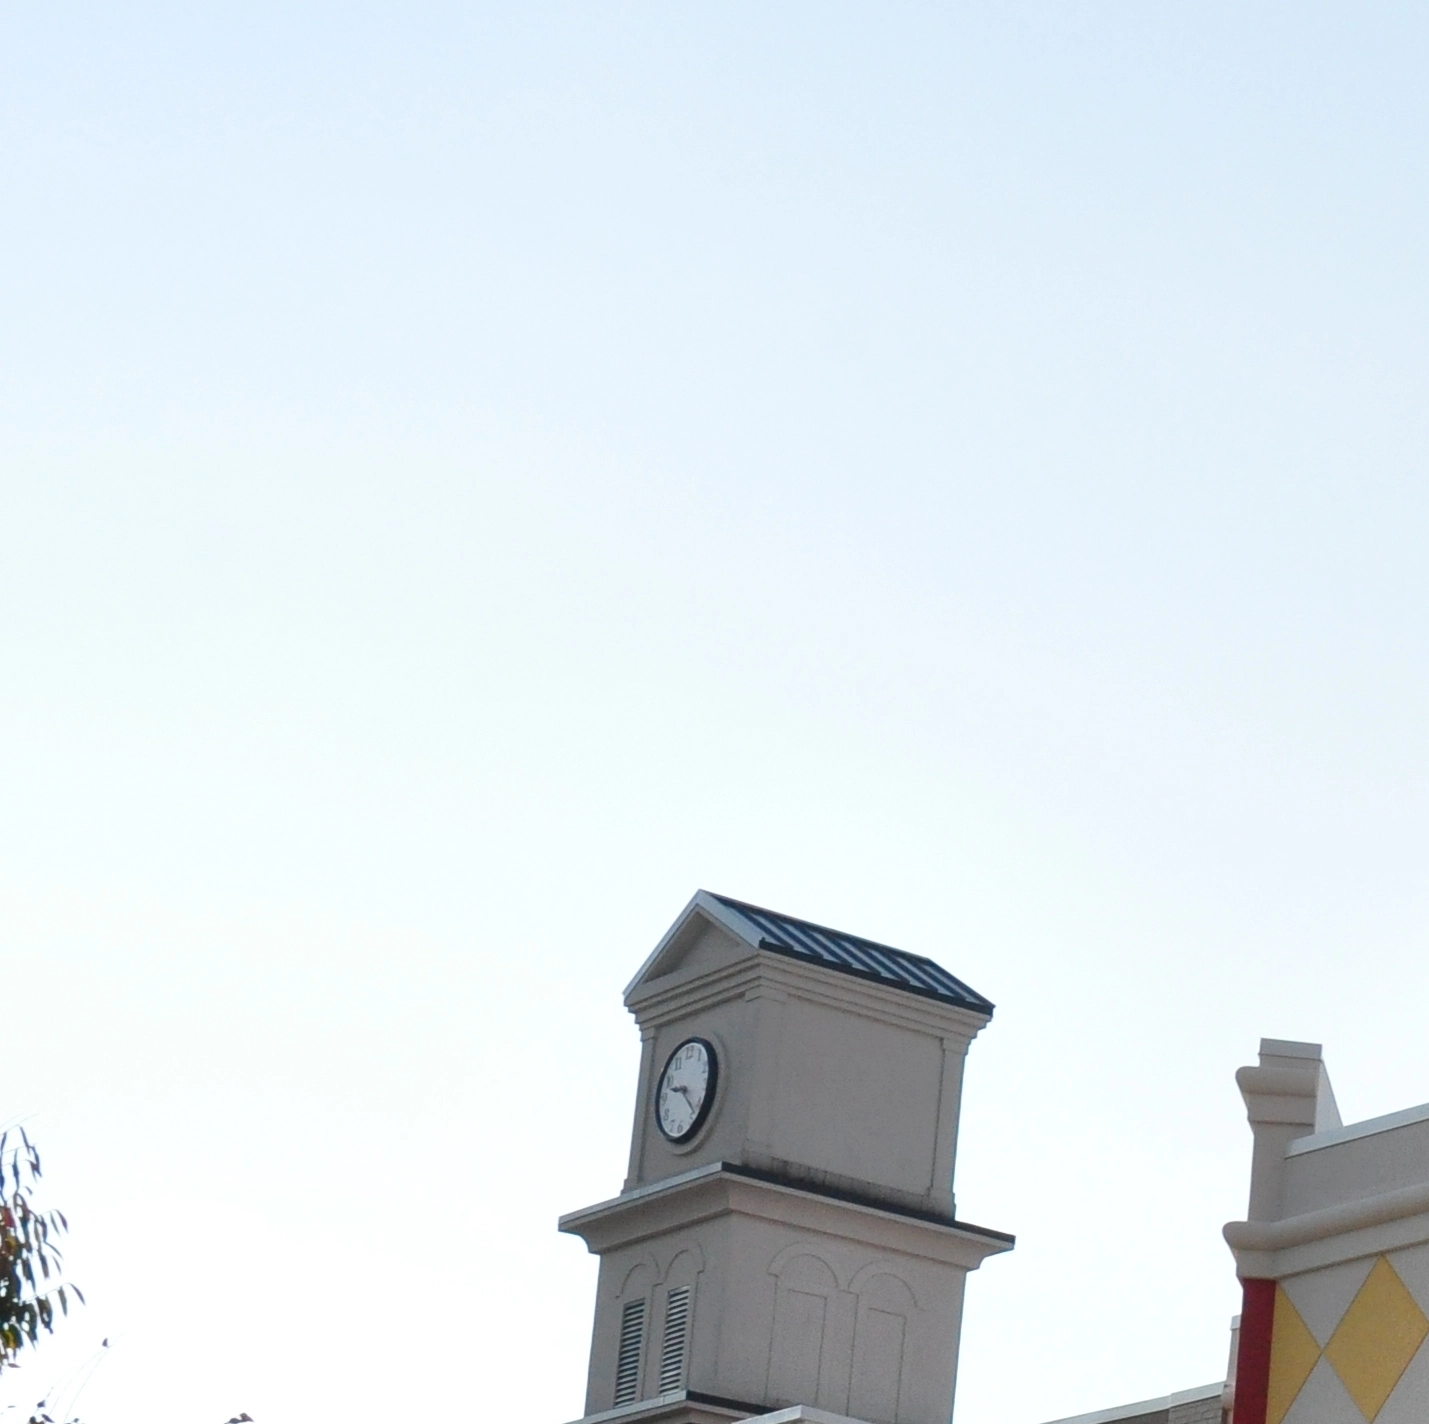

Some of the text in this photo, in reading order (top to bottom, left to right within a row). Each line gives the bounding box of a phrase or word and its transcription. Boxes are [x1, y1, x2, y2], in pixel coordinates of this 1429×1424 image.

[685, 1045, 695, 1061] 12
[674, 1056, 682, 1071] 11
[663, 1108, 670, 1121] 8
